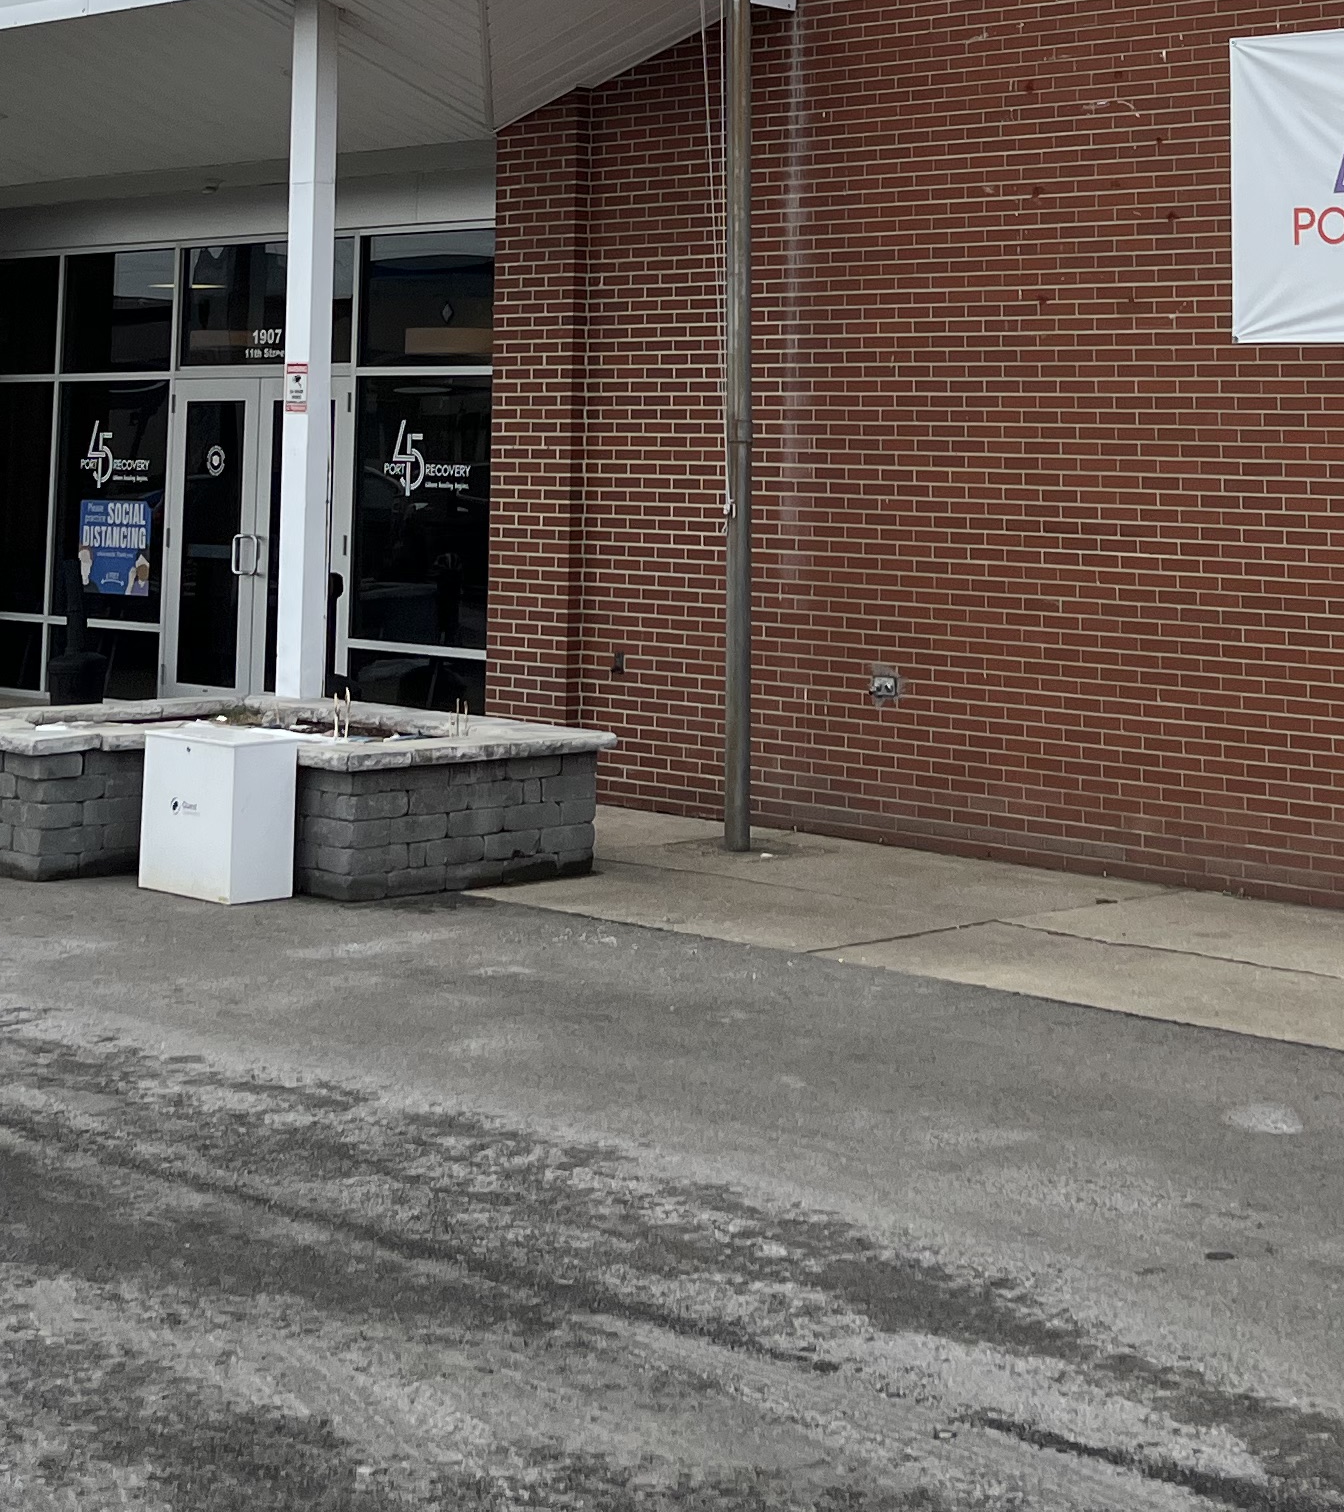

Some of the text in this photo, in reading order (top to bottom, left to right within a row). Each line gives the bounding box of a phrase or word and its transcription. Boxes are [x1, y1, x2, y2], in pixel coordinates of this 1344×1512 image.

[252, 329, 283, 344] 1907
[383, 462, 405, 475] PORT
[425, 464, 471, 477] RECOVERY
[107, 502, 146, 525] SOCIAL
[82, 525, 146, 549] DISTANCING
